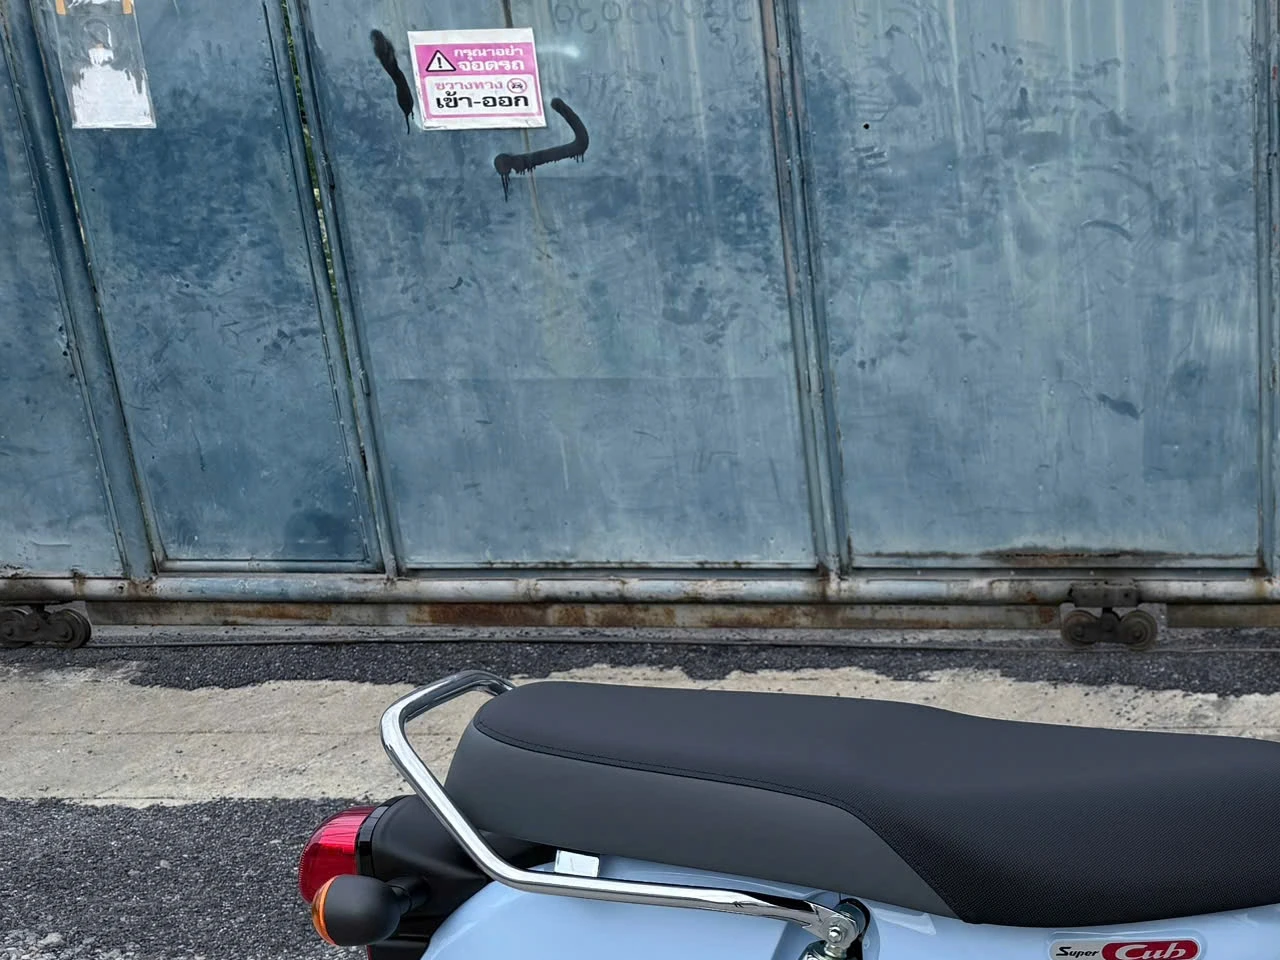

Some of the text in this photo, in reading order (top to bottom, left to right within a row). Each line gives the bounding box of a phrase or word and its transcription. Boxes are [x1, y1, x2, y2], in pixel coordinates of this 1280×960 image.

[458, 59, 525, 72] จอดรถ
[434, 79, 504, 91] ขวางทาง
[435, 91, 529, 109] เข้า-ออก
[1055, 942, 1186, 960] Super Cub
